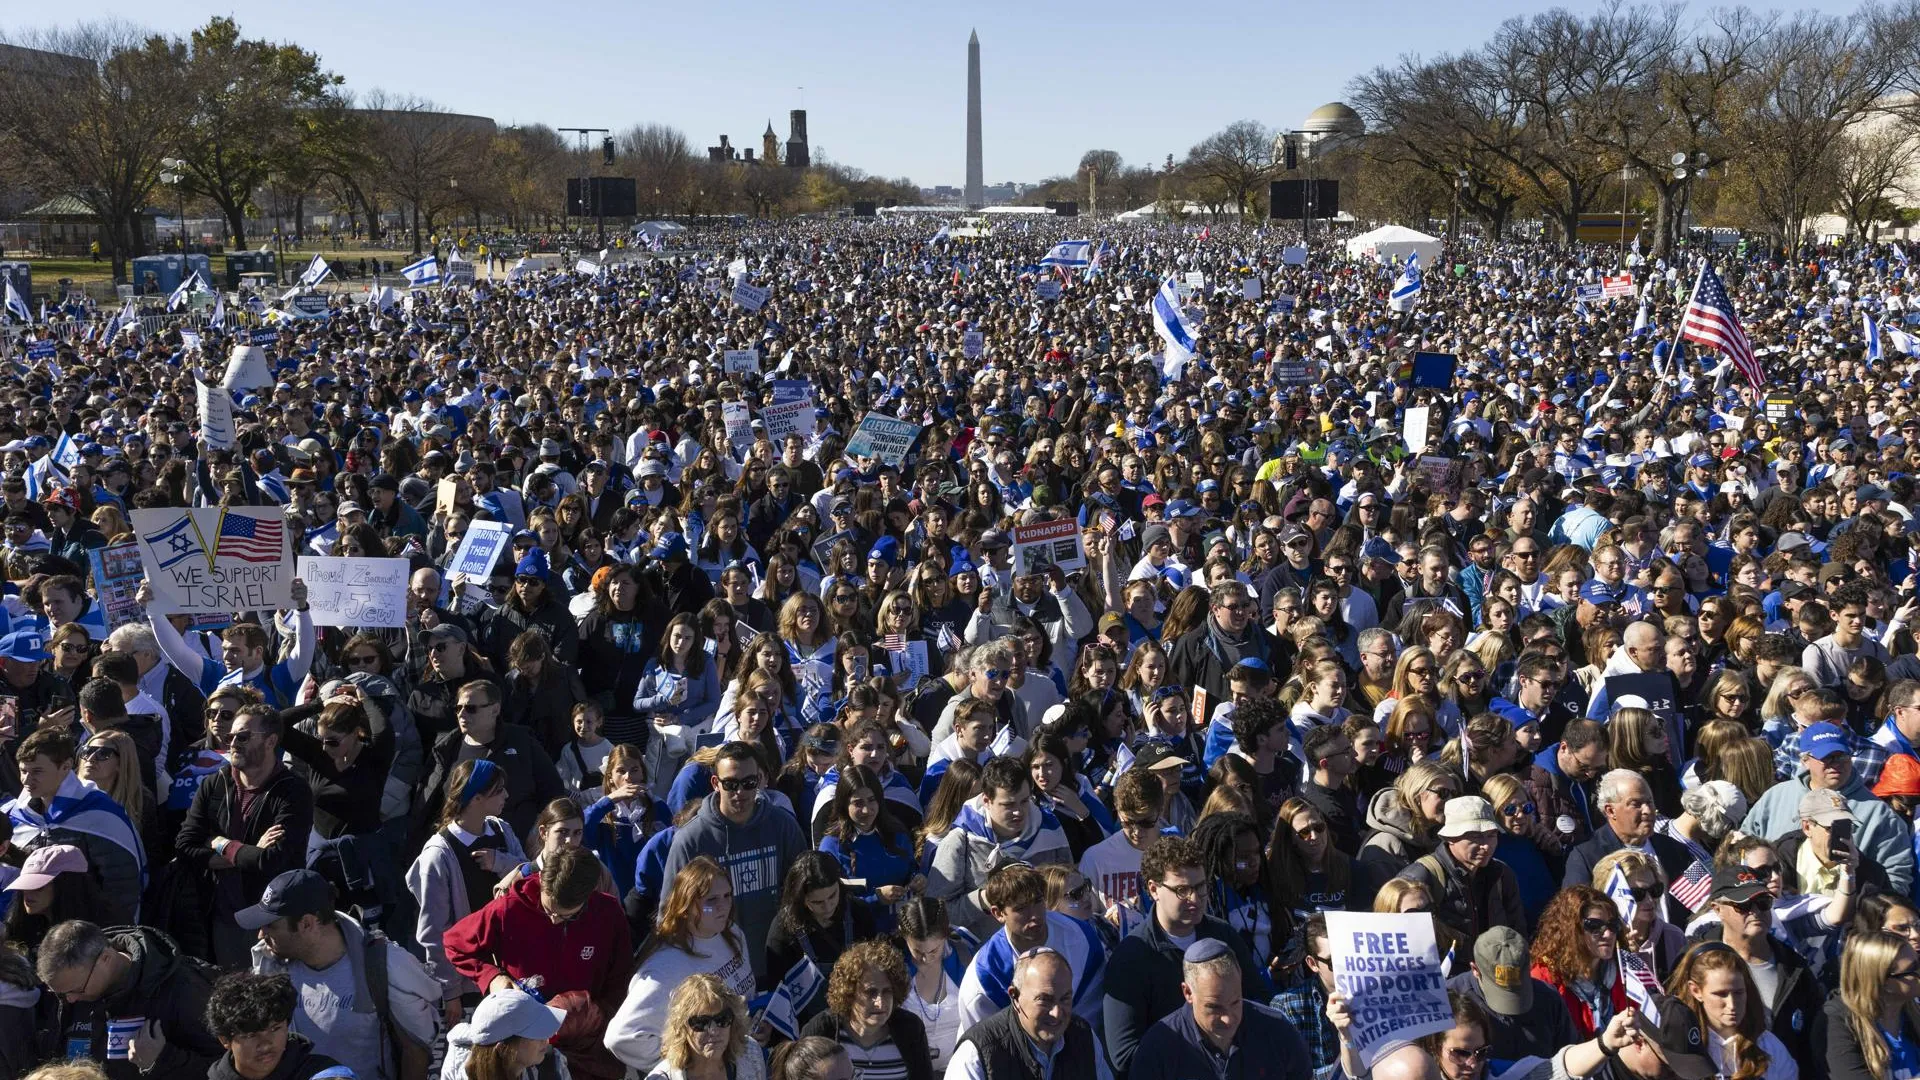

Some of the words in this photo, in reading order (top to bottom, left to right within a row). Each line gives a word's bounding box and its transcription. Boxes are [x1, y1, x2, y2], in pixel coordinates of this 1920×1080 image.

[736, 287, 761, 302] ISRAEL
[251, 332, 280, 342] HOME
[765, 401, 811, 416] HADASSAH
[766, 411, 799, 423] STANDS
[767, 419, 791, 429] WITH
[729, 429, 752, 438] ISRAEL
[769, 425, 799, 436] ISRAEL
[865, 419, 912, 434] CLEVELAND
[872, 433, 909, 445] STRONGER
[868, 442, 888, 453] THAN
[887, 444, 907, 455] HATE
[473, 529, 501, 541] BRING
[1019, 522, 1075, 540] KIDNAPPED
[469, 545, 494, 557] THEM
[170, 565, 203, 585] WE
[212, 564, 281, 584] SUPPORT
[307, 561, 346, 583] Proud
[460, 561, 486, 573] HOME
[177, 584, 276, 608] ISRAEL
[344, 593, 395, 625] Jew
[175, 777, 194, 788] DC
[1352, 932, 1410, 955] FREE
[1344, 956, 1427, 973] HOSTAGES
[1336, 972, 1443, 997] SUPPORT
[1364, 993, 1419, 1007] ISRAEL
[1351, 1001, 1442, 1029] COMBAT
[1353, 1012, 1456, 1053] ANTISEMITISM
